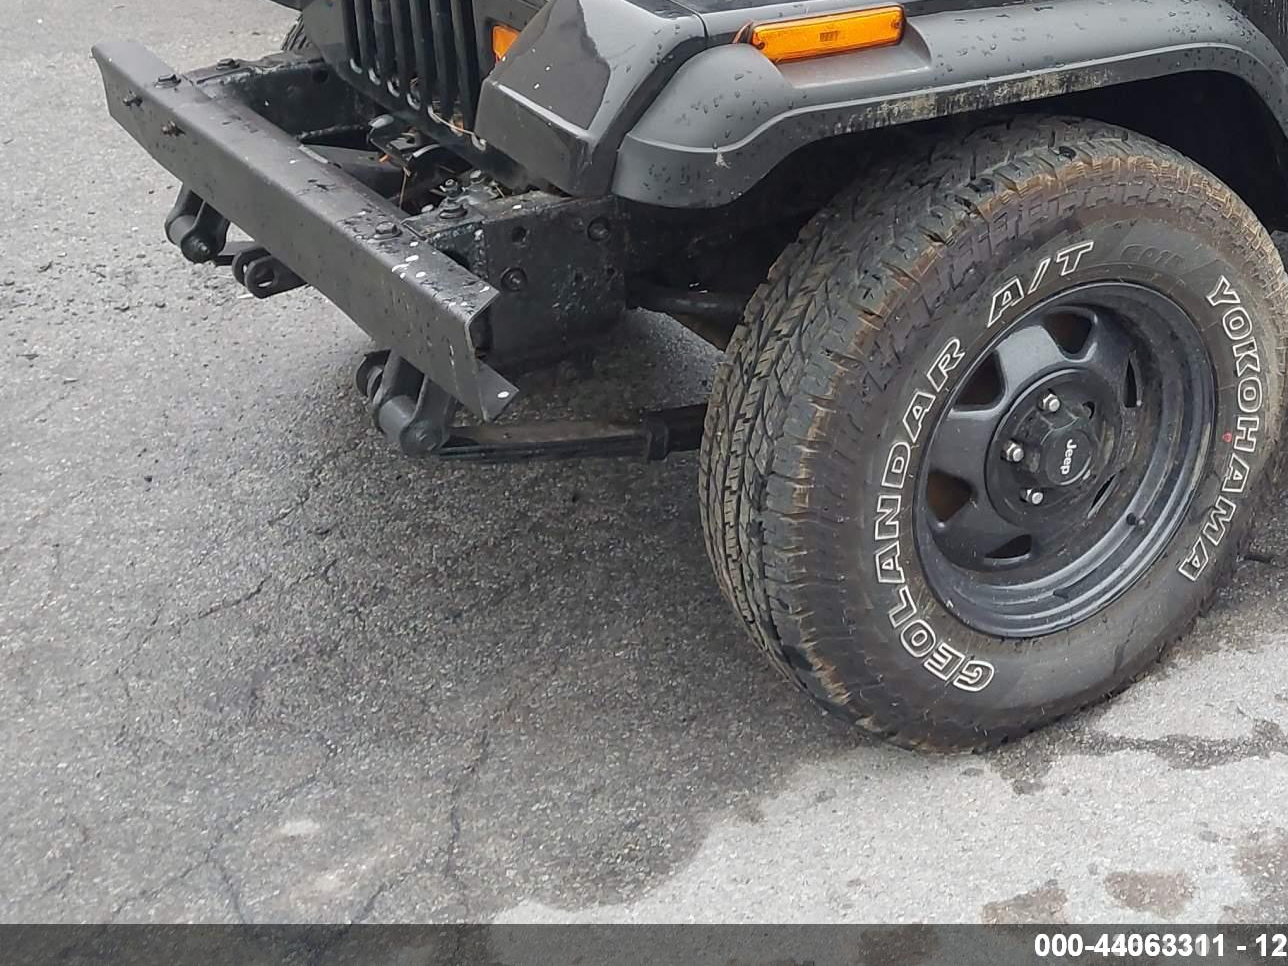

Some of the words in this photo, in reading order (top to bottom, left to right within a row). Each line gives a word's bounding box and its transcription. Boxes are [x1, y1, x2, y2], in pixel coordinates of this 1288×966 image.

[875, 337, 995, 692] GEOLANDAR
[987, 241, 1094, 328] A/T
[1060, 438, 1077, 475] Jeep
[1178, 275, 1263, 582] YOKOHAMA
